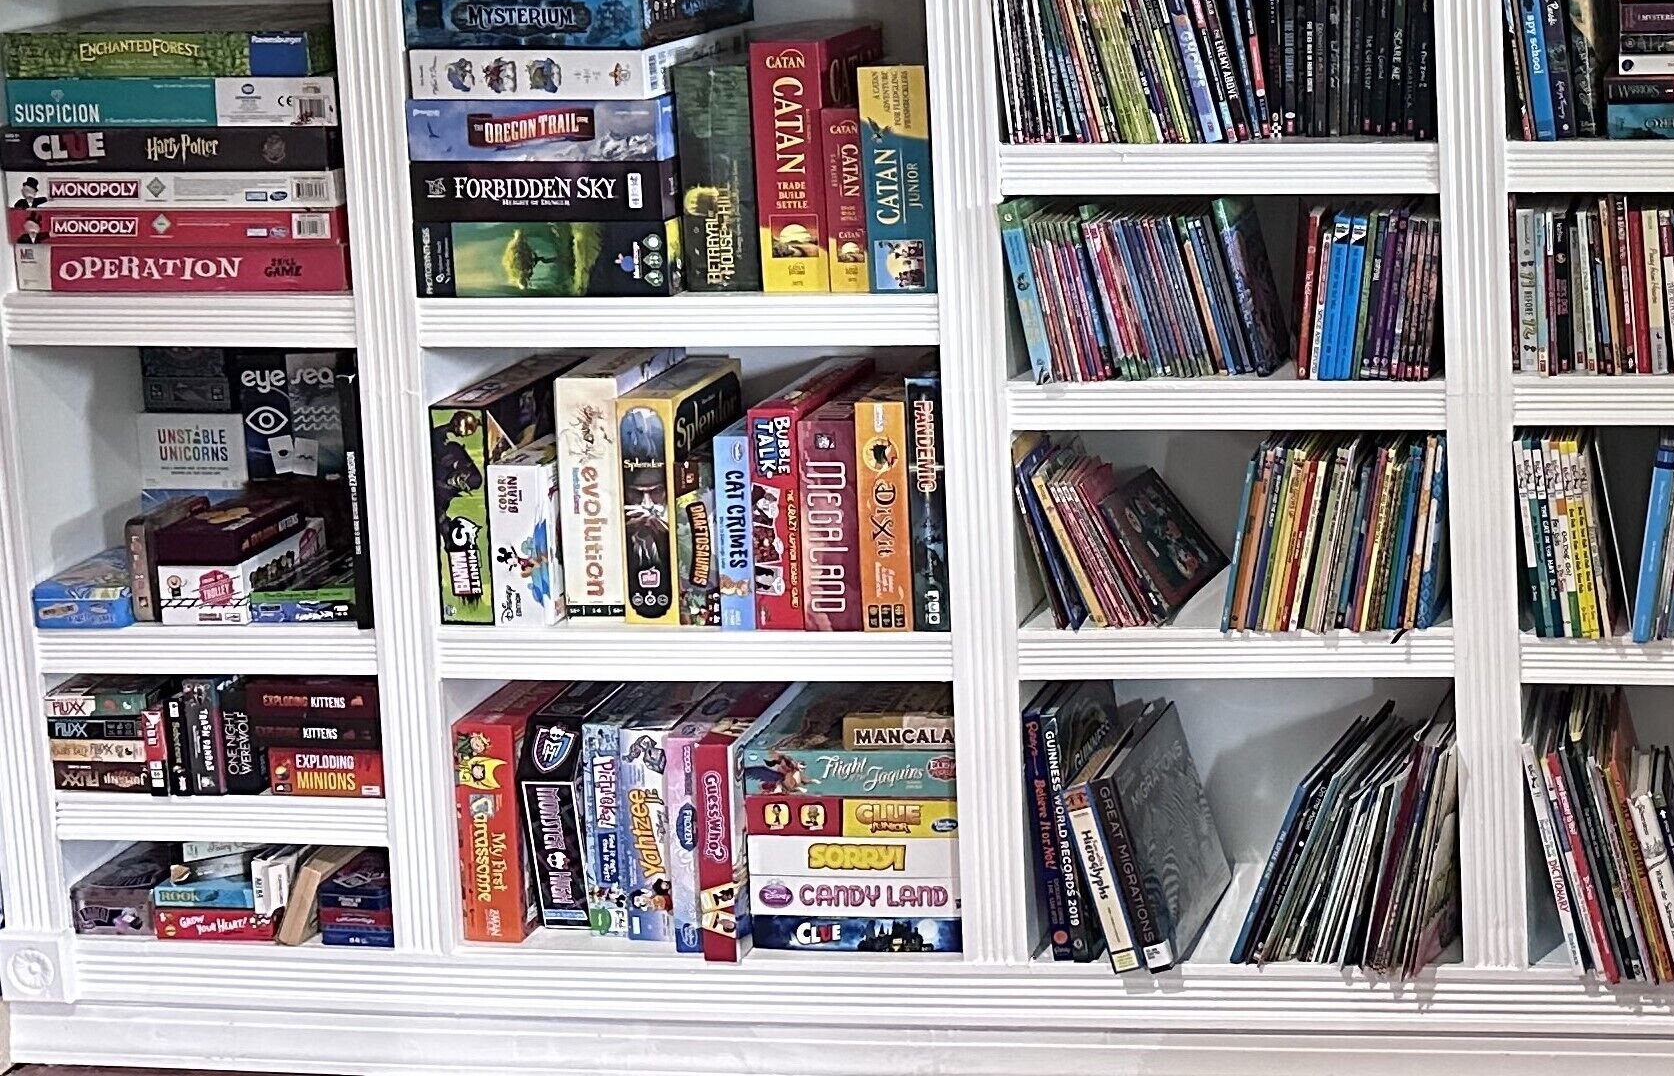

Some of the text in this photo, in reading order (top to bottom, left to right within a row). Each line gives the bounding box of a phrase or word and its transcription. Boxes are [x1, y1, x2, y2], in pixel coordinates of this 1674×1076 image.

[467, 5, 574, 30] MYSTERIUM
[80, 39, 200, 62] ENCHANTED FOREST
[1525, 14, 1545, 75] spy school
[766, 56, 805, 69] CATAN
[15, 103, 99, 123] SUSPICION
[772, 76, 806, 173] CATAN
[830, 125, 857, 134] CATAN
[33, 132, 106, 161] CLUE
[146, 134, 219, 165] Harry Potter
[840, 144, 860, 197] CATAN
[51, 182, 137, 197] MONOPOLY
[454, 176, 618, 200] FORBIDDEN SKY
[777, 182, 806, 190] TRADE
[778, 192, 805, 200] BUILD
[874, 148, 901, 225] CATAN
[907, 162, 924, 208] JUNIOR
[776, 200, 808, 209] SETTLE
[54, 220, 135, 234] MONOPOLY
[707, 212, 721, 285] BETRAYAL
[59, 257, 243, 281] OPERATION
[264, 265, 303, 277] GAME
[241, 368, 334, 393] eye sea
[160, 446, 228, 462] UNICORNS
[757, 422, 777, 478] TALK
[773, 416, 791, 474] BUBBLE
[914, 400, 937, 492] PANDEMIC
[624, 459, 664, 471] Splendor
[498, 477, 507, 513] COLOR
[507, 475, 518, 513] BRAIN
[580, 465, 607, 597] evolution
[725, 470, 748, 569] CAT CRIMES
[691, 504, 707, 587] DRAFTOSAURUS
[804, 461, 848, 613] MEGALAND
[53, 701, 86, 715] FLUXX
[263, 695, 346, 709] EXPLODING KITTENS
[55, 723, 88, 737] FLUXX
[855, 728, 954, 746] MANCALA
[223, 711, 239, 775] ONE NIGHT
[236, 711, 252, 775] WEREWOLF
[295, 754, 355, 769] EXPLODING
[818, 754, 867, 779] Flight
[297, 771, 356, 791] MINIONS
[683, 809, 695, 845] FROZEN
[856, 804, 921, 825] CLUE
[629, 788, 666, 879] Yahtzee
[870, 822, 909, 834] JUNIOR
[1045, 730, 1080, 926] GUINNESS WORLD RECORDS 2019
[808, 843, 906, 871] SORRY!
[1080, 828, 1109, 901] Hieroglyphs
[1099, 785, 1155, 945] GREAT MIGRATIONS
[160, 890, 200, 902] ROOK
[800, 884, 880, 907] CANDY
[887, 885, 948, 907] LAND
[1549, 858, 1571, 914] DICTIONARY
[179, 914, 206, 928] GROW
[797, 923, 841, 944] CLUE
